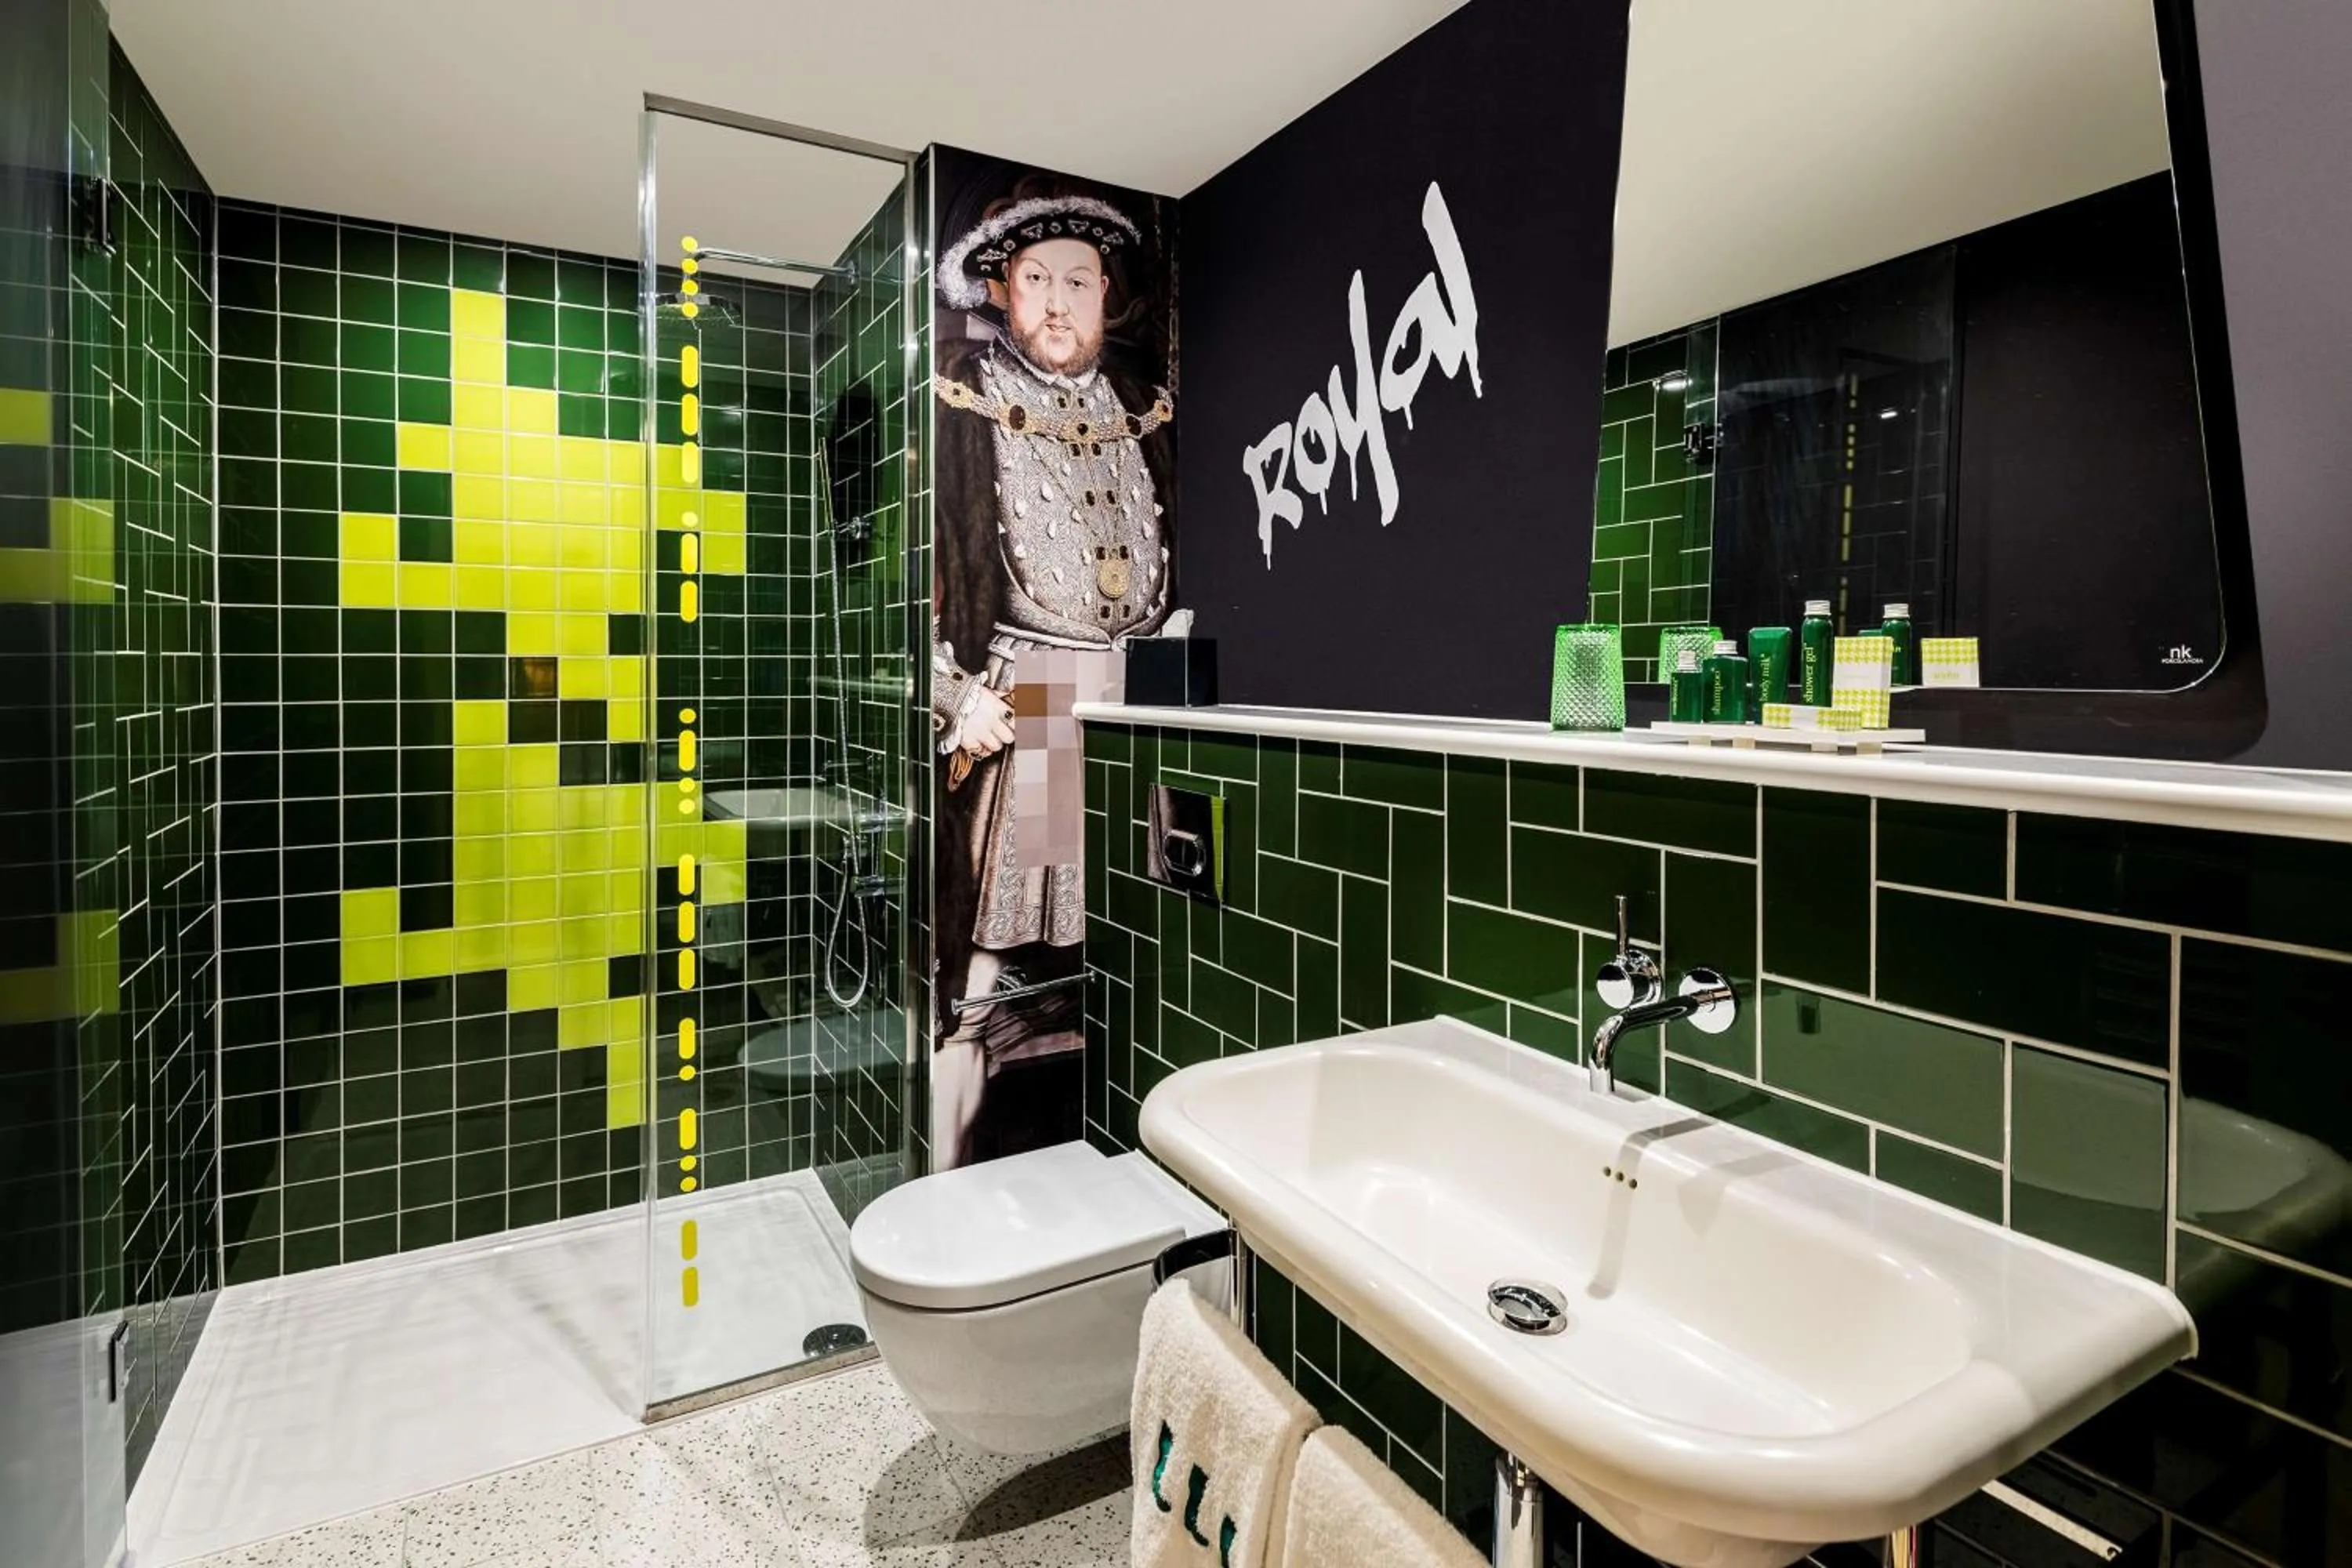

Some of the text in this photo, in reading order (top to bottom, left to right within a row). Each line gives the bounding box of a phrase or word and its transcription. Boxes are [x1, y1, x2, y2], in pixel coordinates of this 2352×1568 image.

[2169, 644, 2191, 659] nk
[1804, 646, 1817, 703] shower gel
